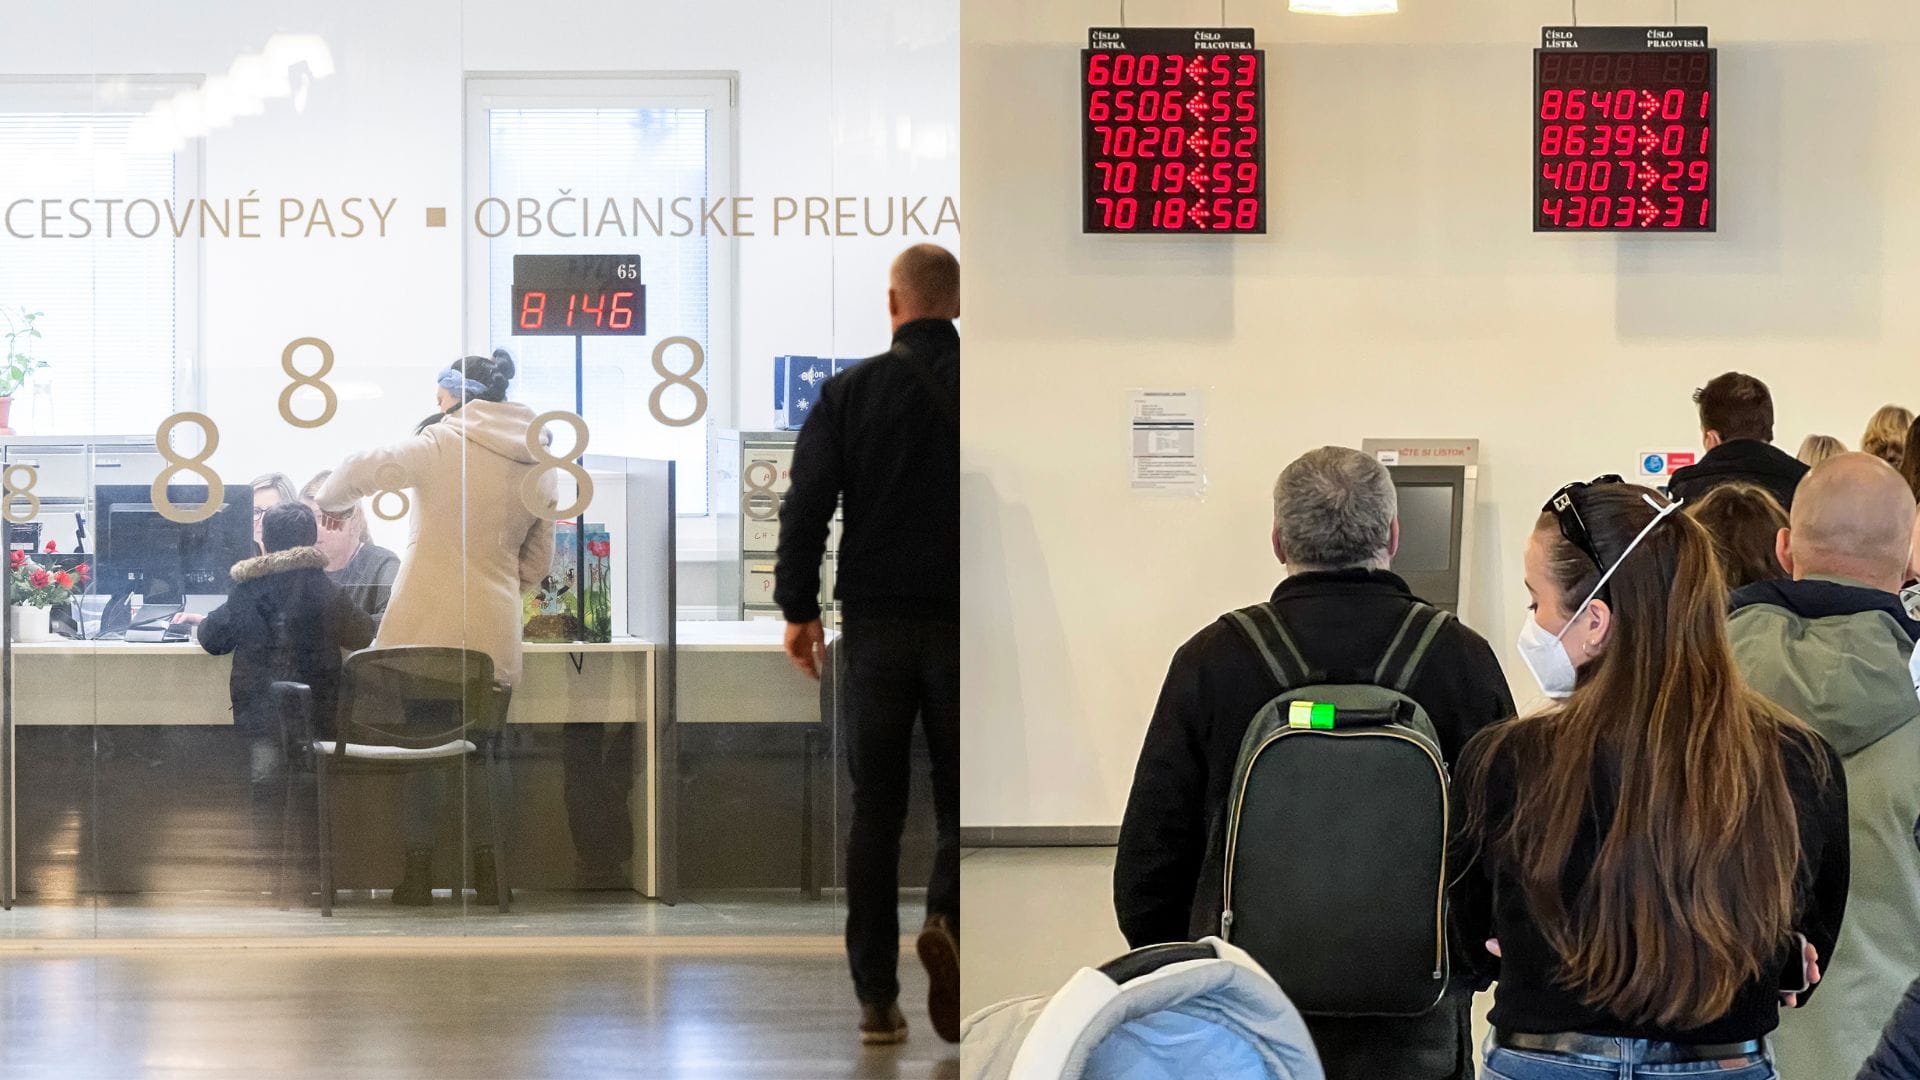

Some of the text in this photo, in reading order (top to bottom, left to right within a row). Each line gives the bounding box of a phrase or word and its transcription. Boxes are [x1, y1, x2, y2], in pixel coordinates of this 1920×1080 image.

[1092, 31, 1120, 40] ČÍSLO
[1092, 40, 1126, 49] LÍSTKA
[1194, 31, 1221, 40] ČÍSLO
[1194, 41, 1253, 49] PRACOVISKA
[1545, 29, 1573, 39] ČÍSLO
[1545, 39, 1579, 48] LÍSTKA
[1647, 29, 1674, 39] ČÍSLO
[1647, 40, 1705, 48] PRACOVISKA
[1088, 54, 1257, 86] 6003 53
[1088, 90, 1256, 122] 6506 55
[1540, 89, 1709, 120] 8640 01
[1094, 126, 1258, 158] 7020 62
[1540, 125, 1709, 156] 8639 01
[1211, 162, 1258, 193] 59
[1542, 161, 1709, 191] 4007 29
[5, 190, 398, 239] CESTOVNÉ PASY
[474, 188, 960, 238] OBČIANSKE PREUKA
[1212, 197, 1258, 229] 58
[1542, 196, 1709, 227] 4303 31
[617, 263, 637, 279] 65
[519, 291, 634, 329] 8146
[278, 337, 338, 428] 8
[647, 336, 708, 427] 8
[150, 411, 225, 524] 8
[522, 411, 594, 521] 8
